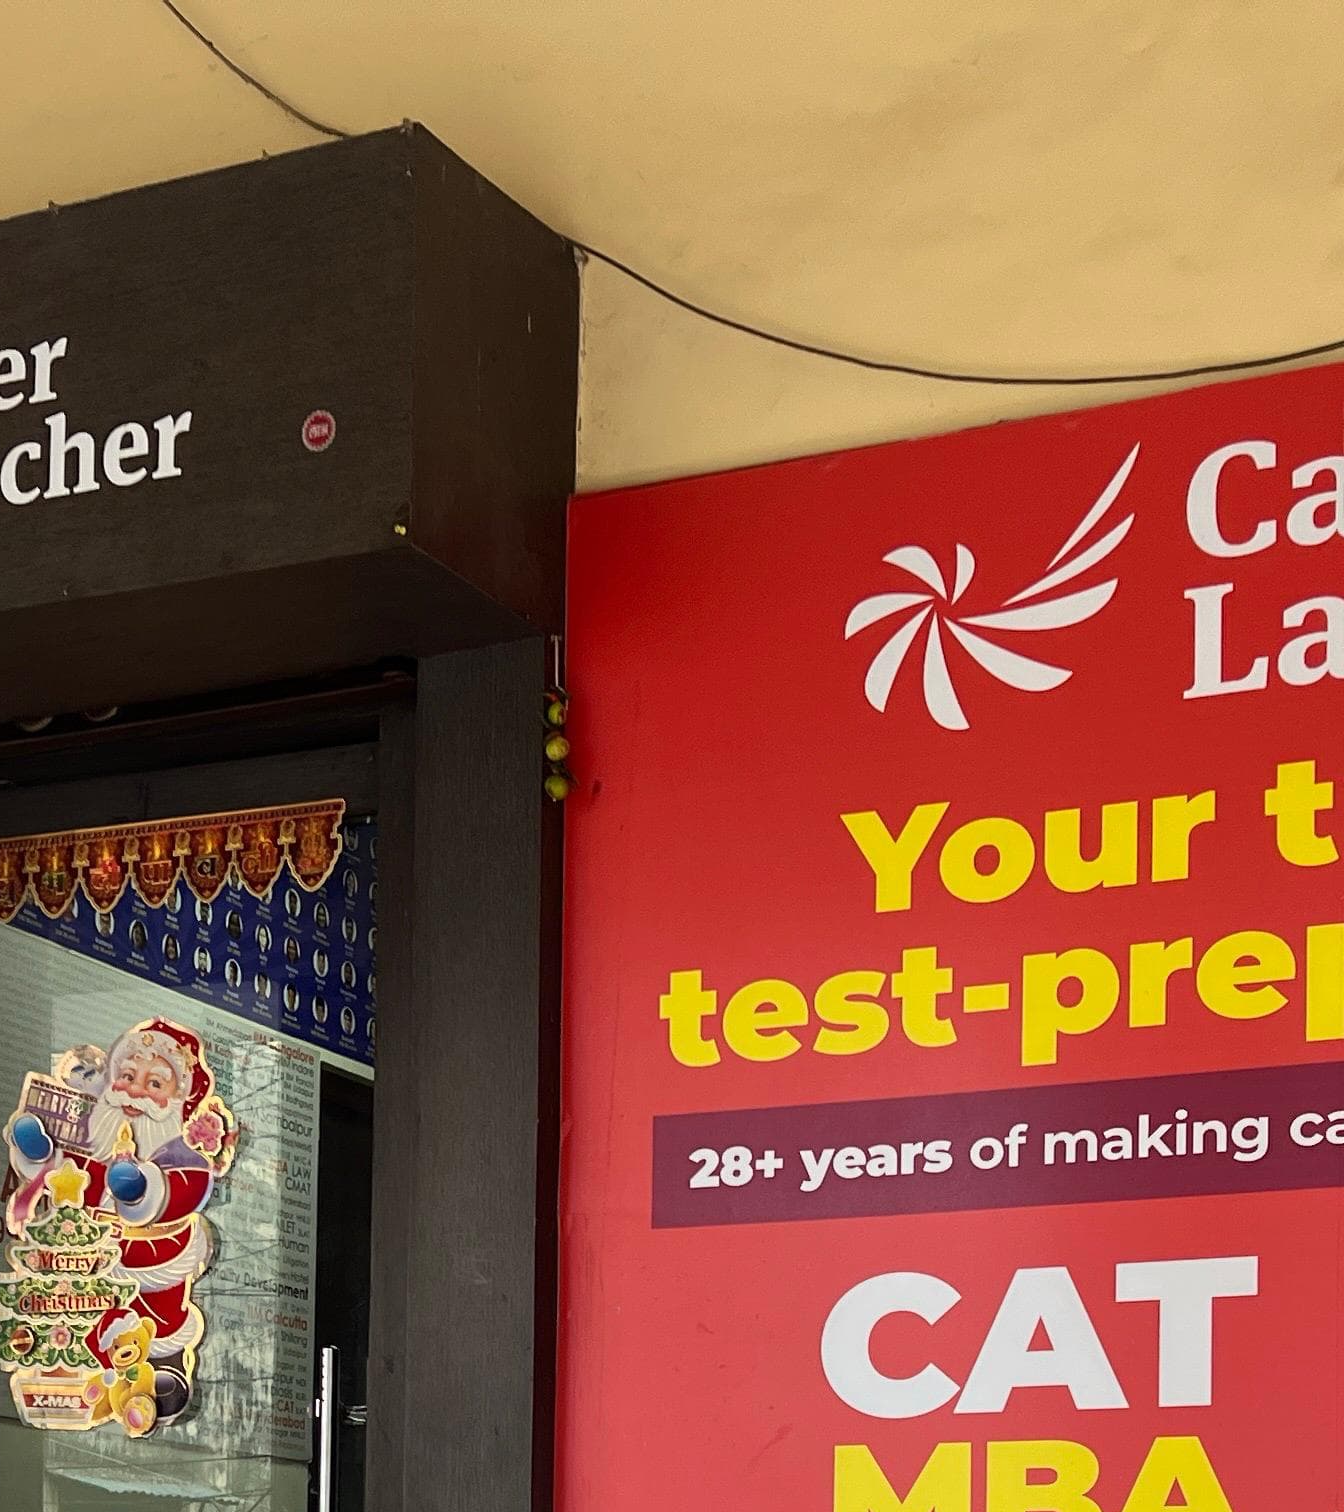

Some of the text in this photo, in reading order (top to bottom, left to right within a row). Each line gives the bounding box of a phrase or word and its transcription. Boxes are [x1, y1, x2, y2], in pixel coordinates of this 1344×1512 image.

[841, 790, 1216, 913] Your
[688, 1145, 784, 1189] 28+
[799, 1139, 953, 1192] years
[969, 1123, 1029, 1170] of
[1044, 1114, 1269, 1165] making
[38, 1250, 99, 1275] Merry
[244, 1271, 309, 1301] Development
[19, 1291, 115, 1315] Christmas
[265, 1308, 308, 1331] Calcutta
[820, 1255, 1259, 1419] CAT
[32, 1393, 82, 1409] X-MAS
